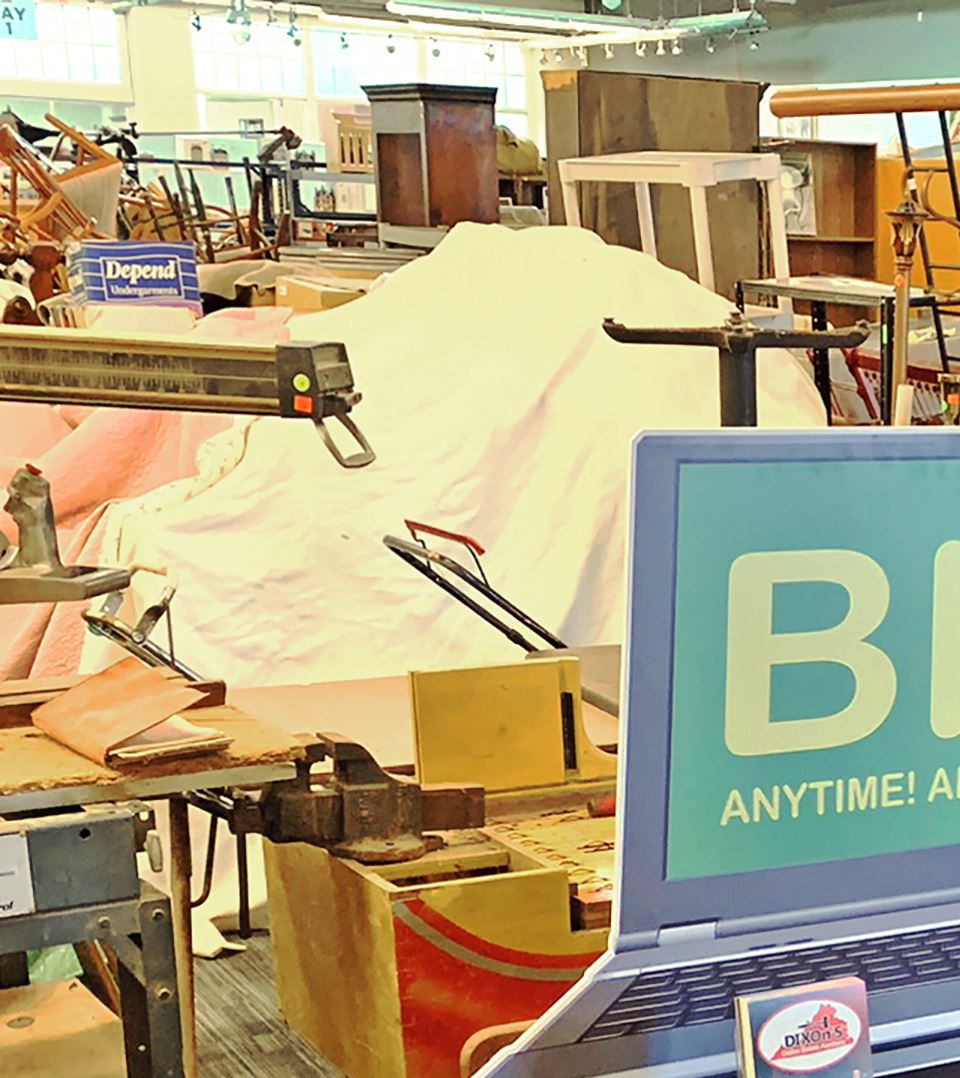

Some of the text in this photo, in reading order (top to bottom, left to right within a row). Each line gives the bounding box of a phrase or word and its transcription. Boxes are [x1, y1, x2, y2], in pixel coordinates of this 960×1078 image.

[2, 6, 26, 21] AY
[5, 22, 12, 35] 1
[106, 260, 177, 285] Depend
[719, 771, 915, 826] ANYTIME!
